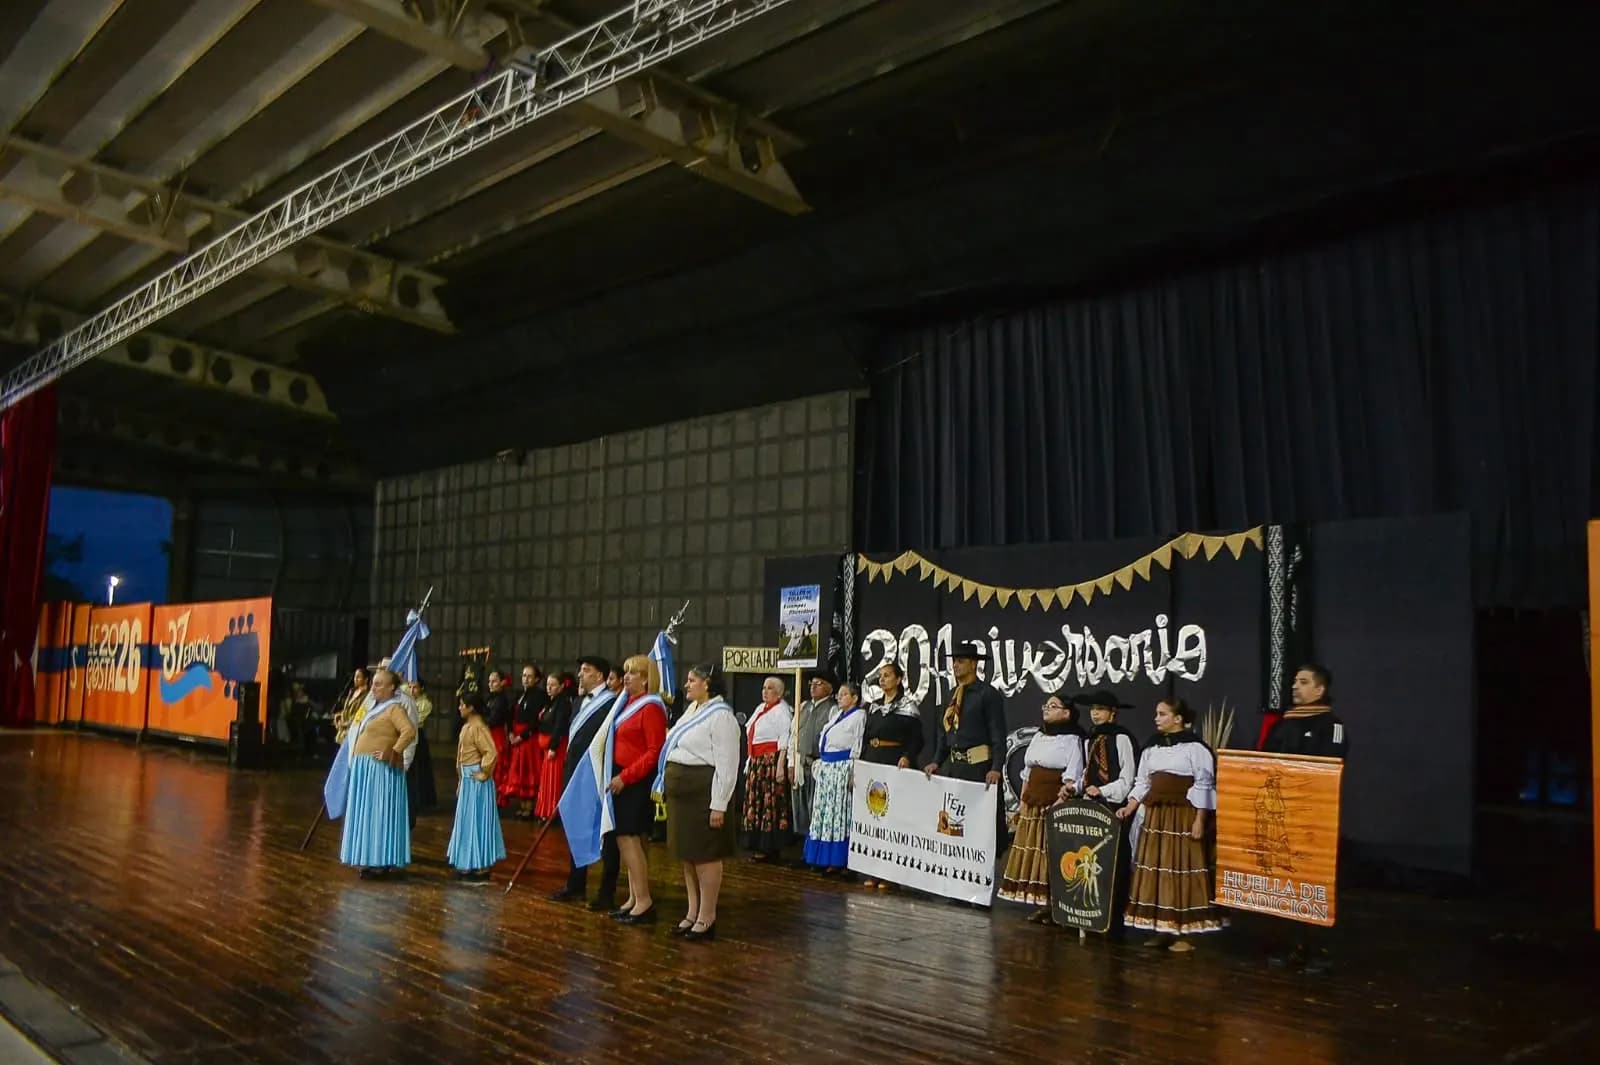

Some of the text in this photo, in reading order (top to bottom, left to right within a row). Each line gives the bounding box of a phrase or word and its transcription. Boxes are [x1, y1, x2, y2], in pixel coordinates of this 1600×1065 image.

[183, 634, 216, 671] EDICIÓN
[1053, 807, 1079, 819] INSTITUTO
[1224, 871, 1326, 902] HUELLA DE
